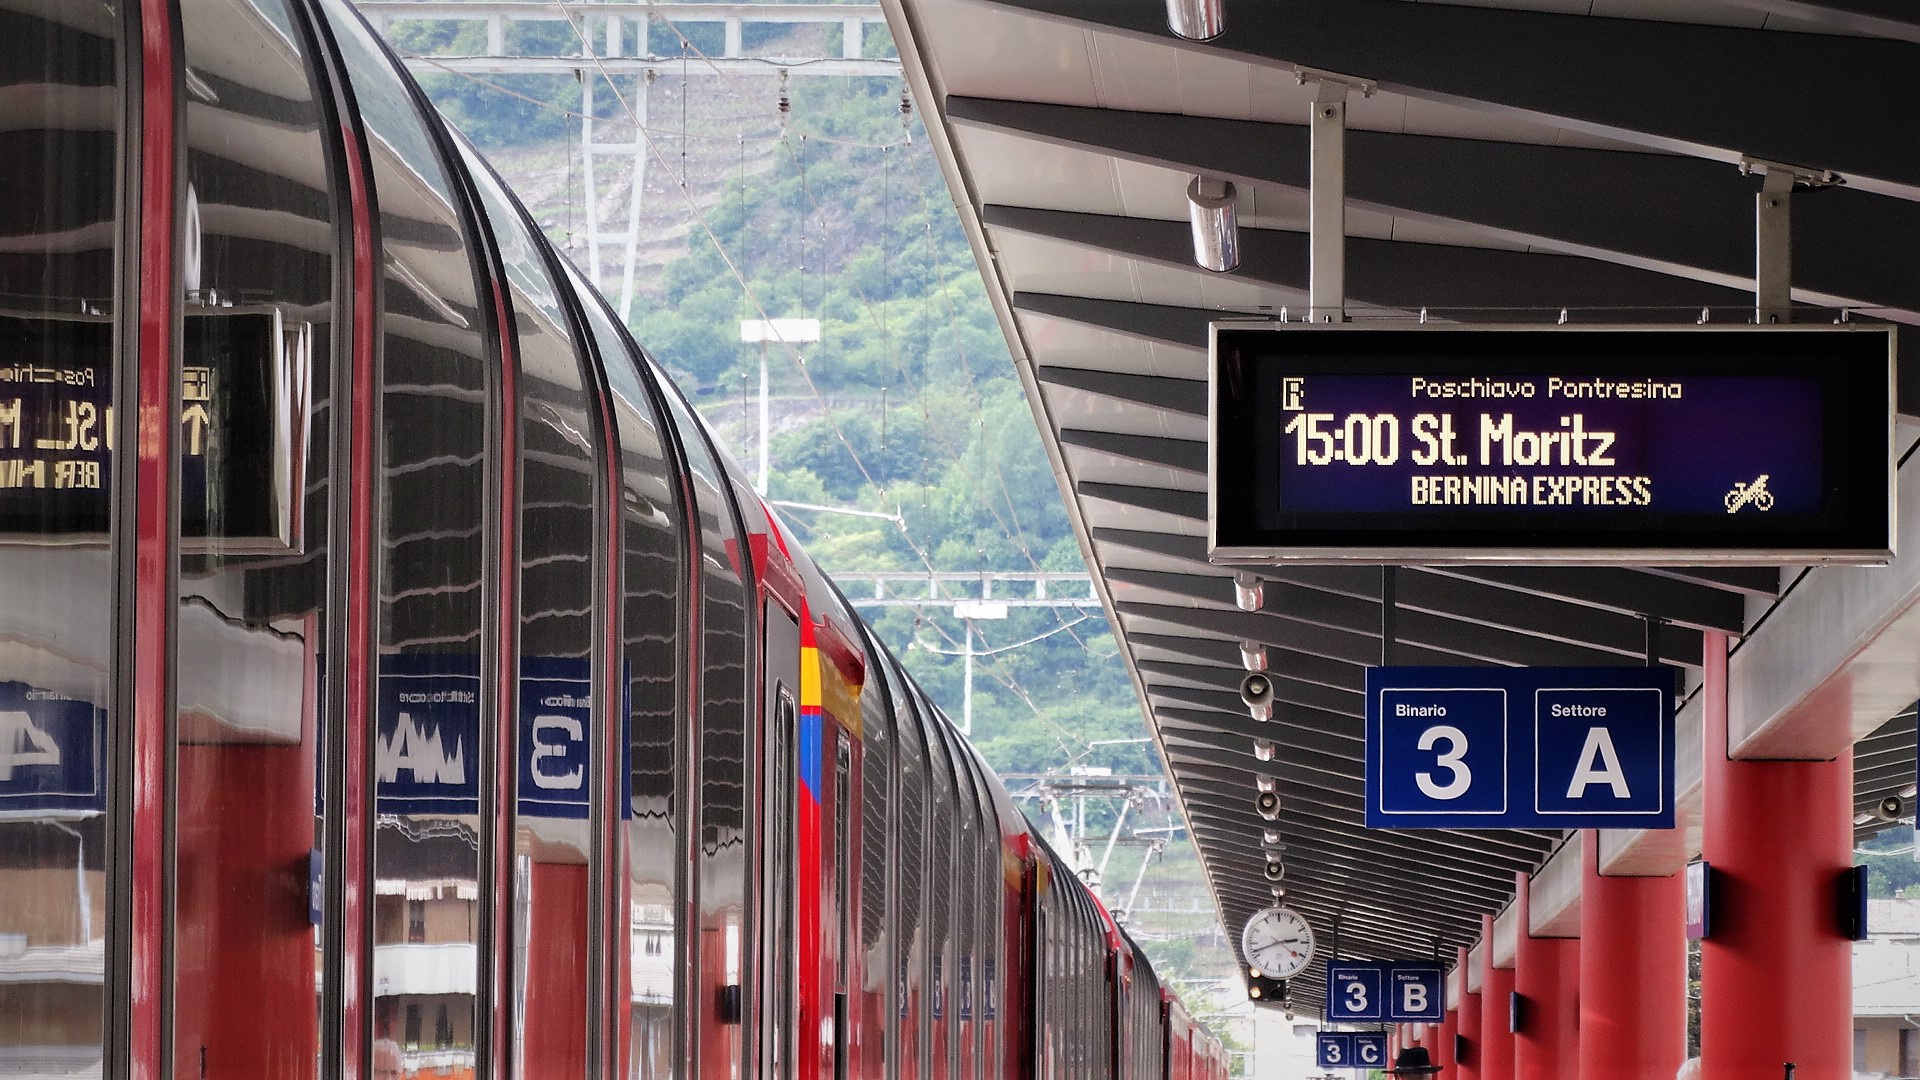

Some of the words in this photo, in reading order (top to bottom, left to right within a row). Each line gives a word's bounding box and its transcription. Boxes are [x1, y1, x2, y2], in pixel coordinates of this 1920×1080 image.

[1411, 377, 1535, 399] Poschiavo
[1548, 377, 1682, 399] Pontresina
[1285, 413, 1399, 466] 15:00
[1411, 413, 1467, 466] St.
[1480, 413, 1616, 466] Moritz
[1411, 475, 1527, 505] BERNINA
[1532, 475, 1652, 506] EXPRESS
[1396, 703, 1447, 717] Binario
[1551, 703, 1607, 717] Settore
[1415, 725, 1472, 800] 3
[1566, 727, 1631, 799] A
[1345, 982, 1368, 1012] 3
[1403, 983, 1428, 1012] B
[1326, 1044, 1342, 1063] 3
[1361, 1044, 1379, 1063] C
